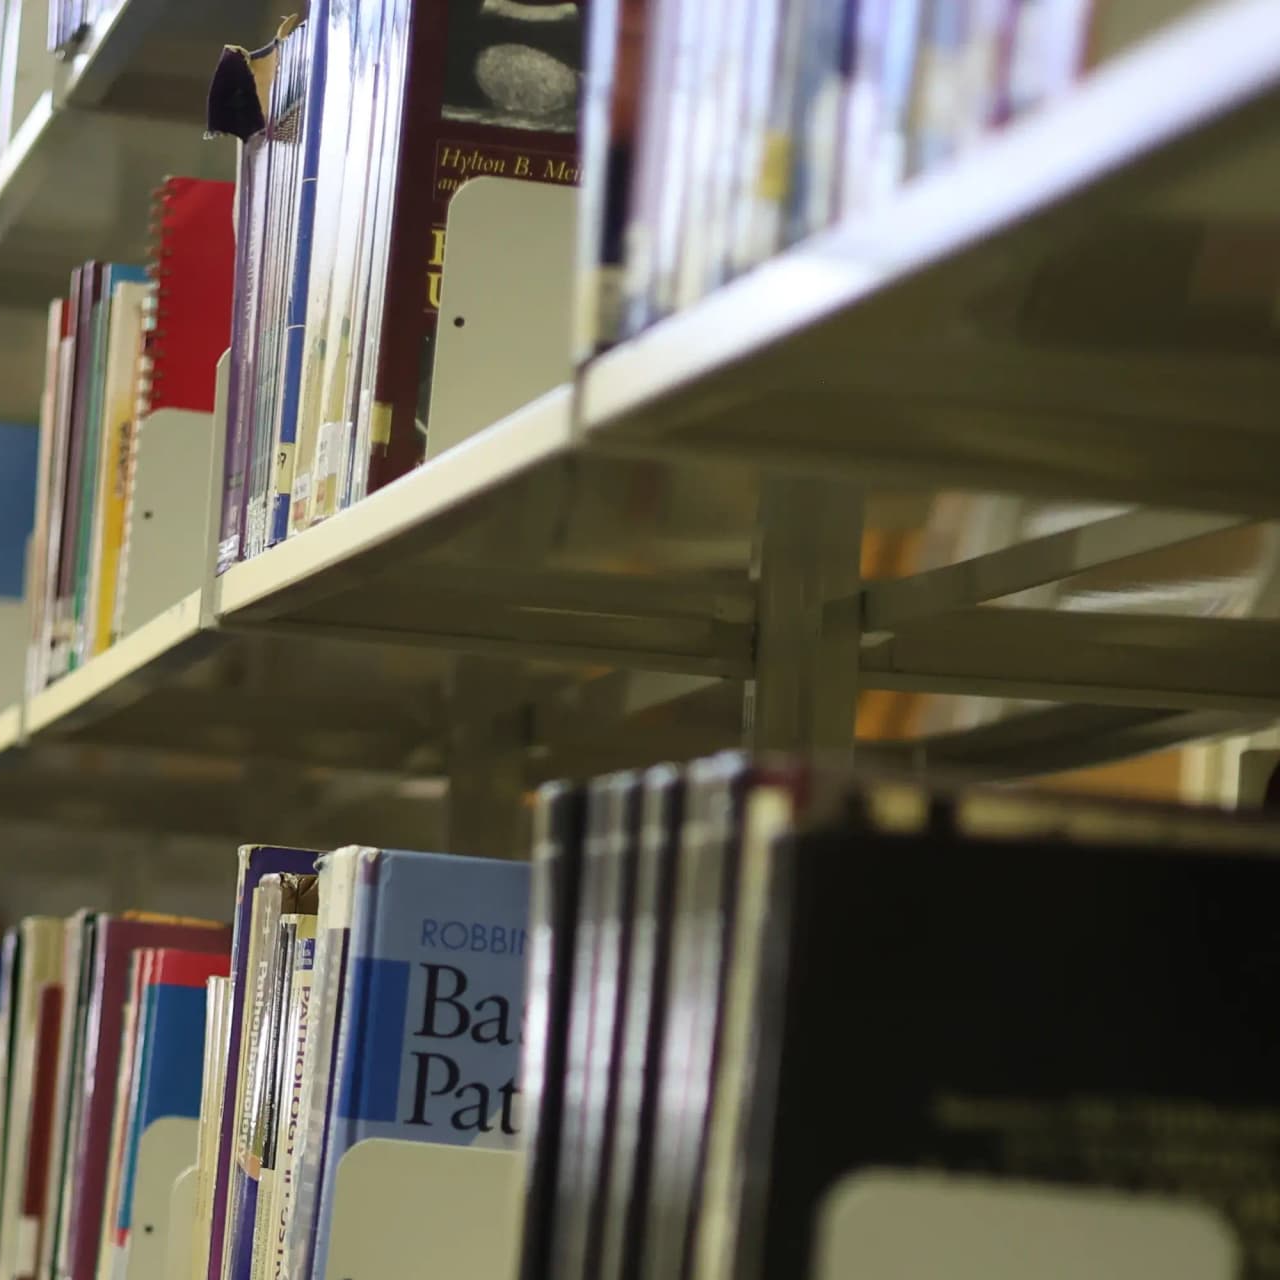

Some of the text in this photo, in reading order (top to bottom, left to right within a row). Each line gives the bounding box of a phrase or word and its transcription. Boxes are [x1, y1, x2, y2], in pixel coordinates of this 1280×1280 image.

[438, 175, 469, 192] an
[440, 147, 506, 174] Hylton
[514, 156, 533, 177] B.
[413, 962, 525, 1046] Ba
[287, 985, 312, 1156] PATHOLOGY
